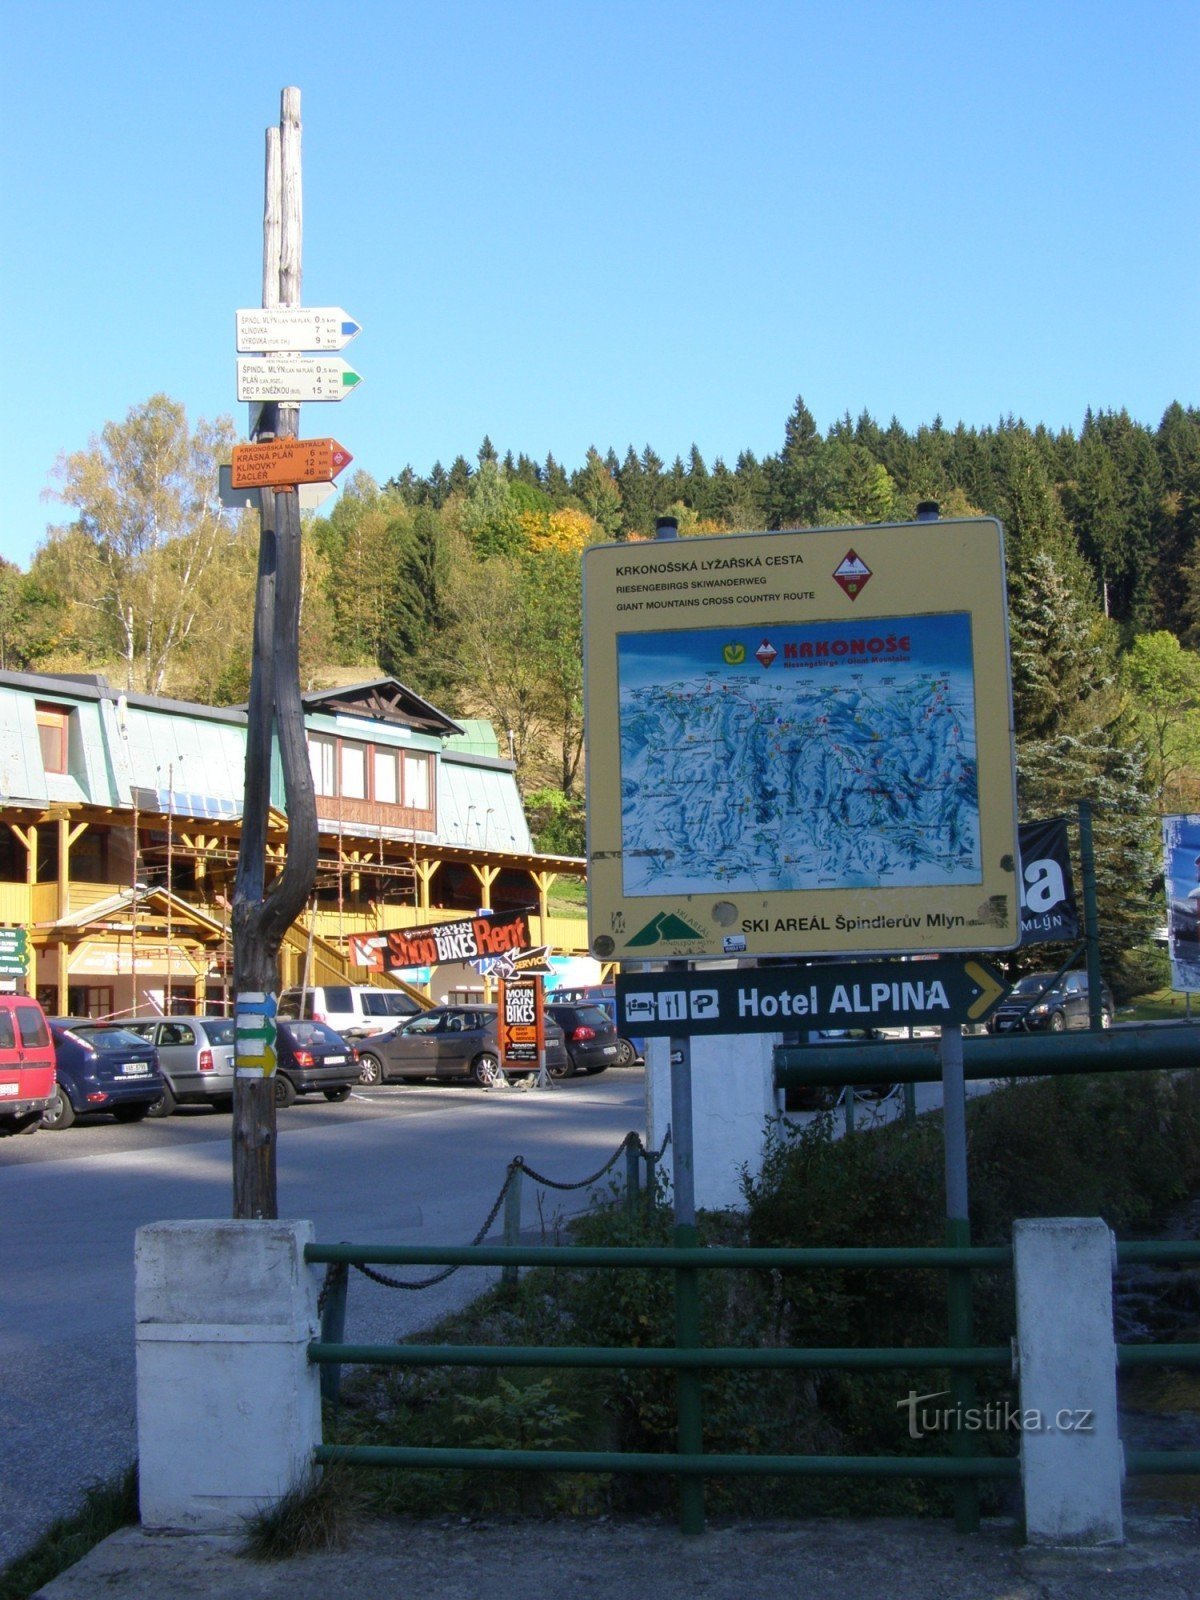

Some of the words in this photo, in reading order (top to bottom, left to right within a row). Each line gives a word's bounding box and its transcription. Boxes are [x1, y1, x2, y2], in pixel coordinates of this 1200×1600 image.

[315, 336, 321, 344] 9
[268, 364, 285, 374] MLÝN
[242, 374, 258, 384] PLÁŇ
[242, 386, 255, 395] PEC
[255, 386, 261, 395] P.
[262, 385, 290, 395] SNĚŽKOU
[312, 386, 322, 395] 15
[284, 441, 326, 449] MAGISTRÁLA
[237, 451, 270, 463] KRÁSNÁ
[272, 448, 294, 459] PLÁŇ
[310, 449, 315, 457] 6
[236, 461, 277, 472] KLÍNOVKY
[304, 458, 315, 466] 12
[615, 560, 698, 577] KRKONOŠSKÁ
[701, 555, 763, 571] LYŽAŘSKÁ
[765, 554, 804, 566] CESTA
[615, 581, 690, 594] RIESENGEBIRGS
[690, 576, 767, 589] SKIWANDERWEG
[616, 602, 644, 612] GIANT
[645, 598, 700, 610] MOUNTAINS
[702, 596, 735, 606] CROSS
[736, 593, 781, 604] COUNTRY
[783, 591, 816, 601] ROUTE
[783, 633, 911, 660] KRKONOŠE
[741, 918, 769, 933] SKI
[774, 914, 831, 932] AREÁL
[835, 913, 921, 932] Špindlerův
[926, 913, 965, 929] Mlyn
[473, 916, 526, 954] Rent
[387, 932, 439, 967] Shop
[434, 933, 478, 961] BIKES
[513, 956, 547, 970] SERVICE
[505, 988, 534, 998] MOUN
[506, 997, 534, 1005] TAIN
[738, 985, 818, 1017] Hotel
[829, 980, 950, 1014] ALPINA
[505, 1004, 535, 1023] BIKES
